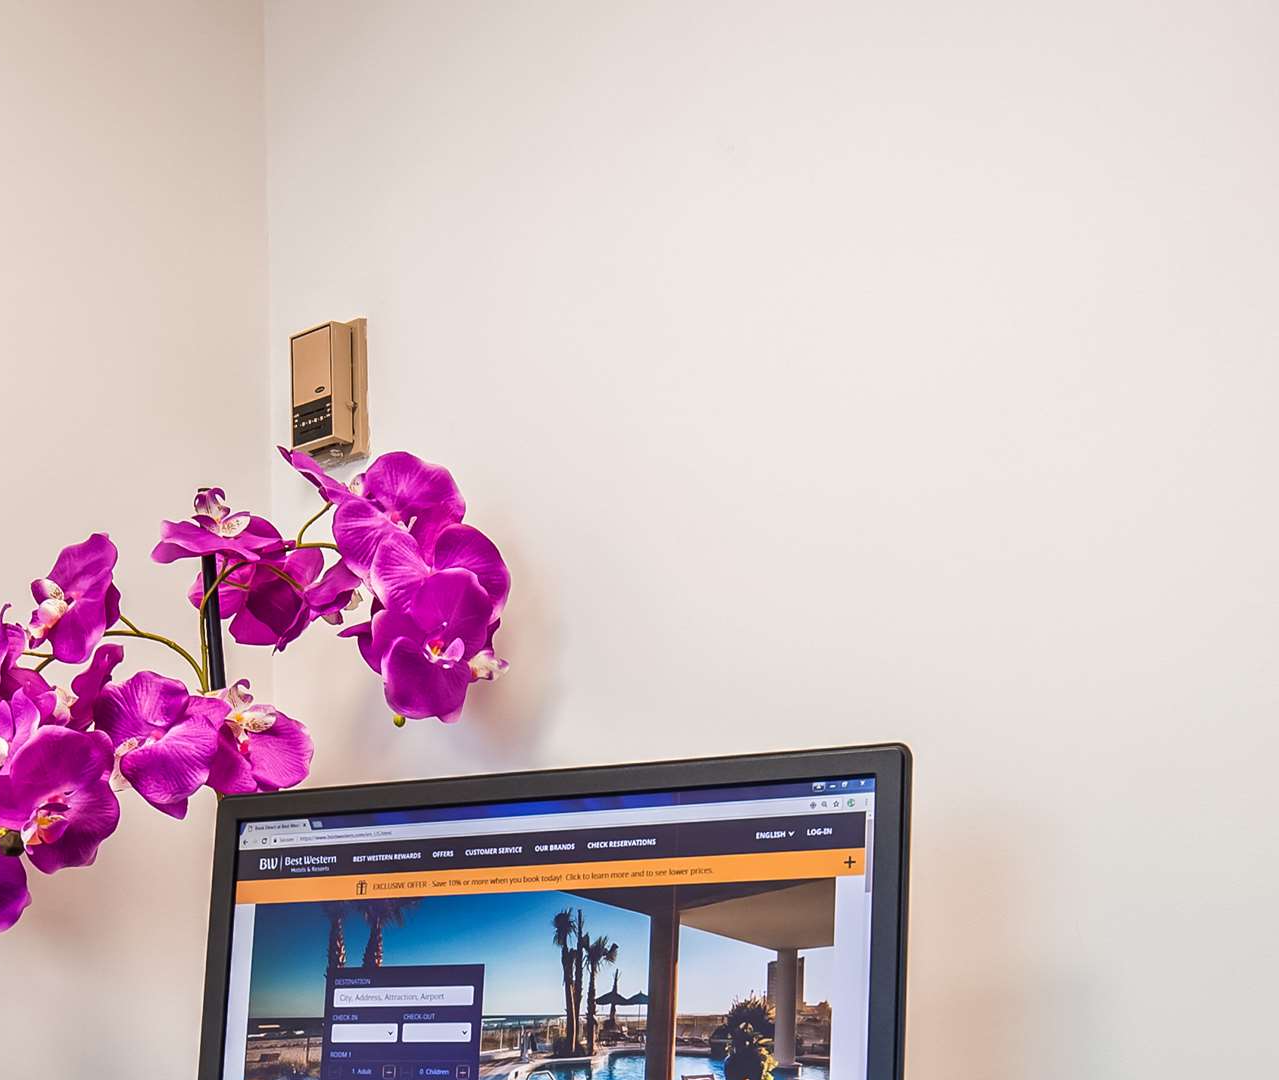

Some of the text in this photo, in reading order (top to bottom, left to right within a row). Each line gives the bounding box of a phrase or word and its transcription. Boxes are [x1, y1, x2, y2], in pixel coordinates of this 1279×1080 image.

[756, 831, 786, 839] ENGLISH
[807, 828, 832, 836] LOG-IN
[550, 843, 576, 851] BRANDS
[587, 839, 656, 849] CHECK RESERVATIONS
[432, 850, 454, 858] OFFERS
[465, 846, 523, 856] CUSTOMER SERVICE
[285, 855, 337, 866] Best Western
[353, 852, 421, 863] BEST WESTERN REWARDS
[259, 858, 278, 870] BW
[372, 881, 405, 890] EXCLUSIVE
[407, 880, 427, 889] OFFER
[490, 876, 508, 884] when
[510, 877, 522, 885] you
[523, 875, 539, 883] book
[541, 875, 562, 884] today!
[690, 867, 714, 876] prices.
[420, 993, 444, 1002] Airport
